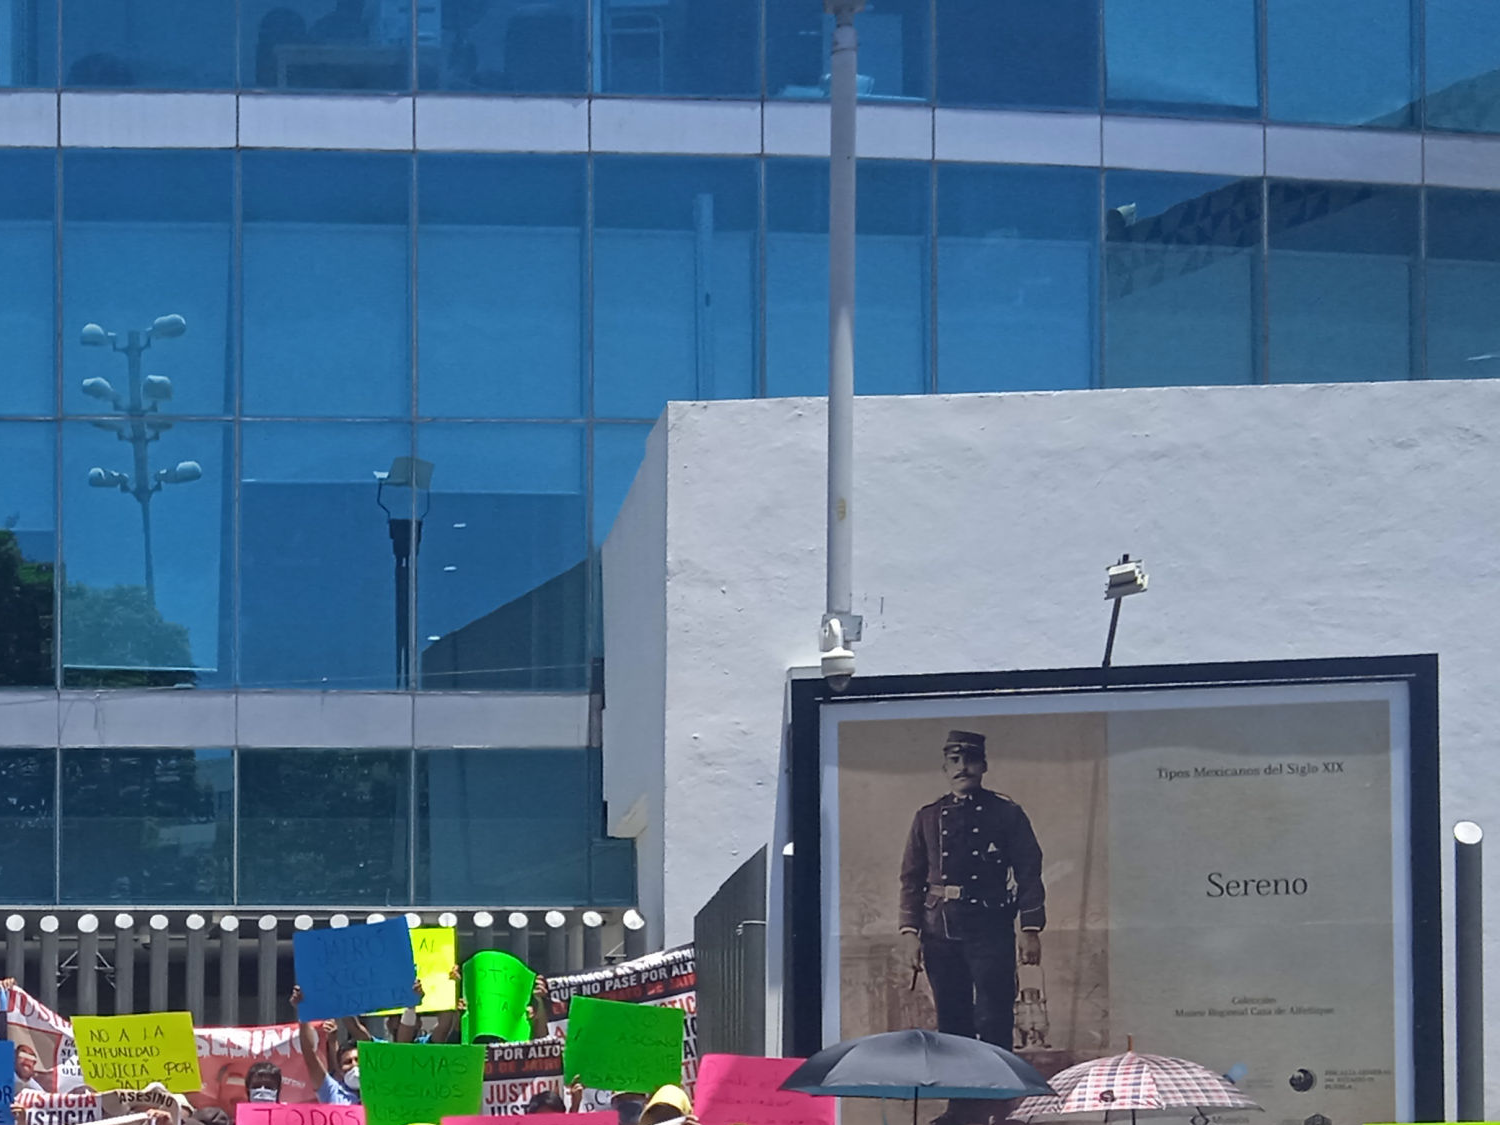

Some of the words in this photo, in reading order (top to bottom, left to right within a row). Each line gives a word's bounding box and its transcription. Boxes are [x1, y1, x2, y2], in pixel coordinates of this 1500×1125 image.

[1157, 767, 1190, 781] Tipos
[1193, 766, 1260, 778] Mexicanos
[1263, 763, 1283, 775] del
[1287, 762, 1318, 777] Siglo
[1322, 762, 1344, 773] XIX
[1206, 872, 1308, 898] Sereno
[581, 980, 601, 996] NO
[605, 975, 638, 993] PASE
[641, 968, 668, 984] POR
[89, 1028, 111, 1044] NO
[86, 1045, 161, 1060] IMPUNIDAD
[495, 1048, 525, 1062] POR
[118, 1091, 175, 1109] ASESINO
